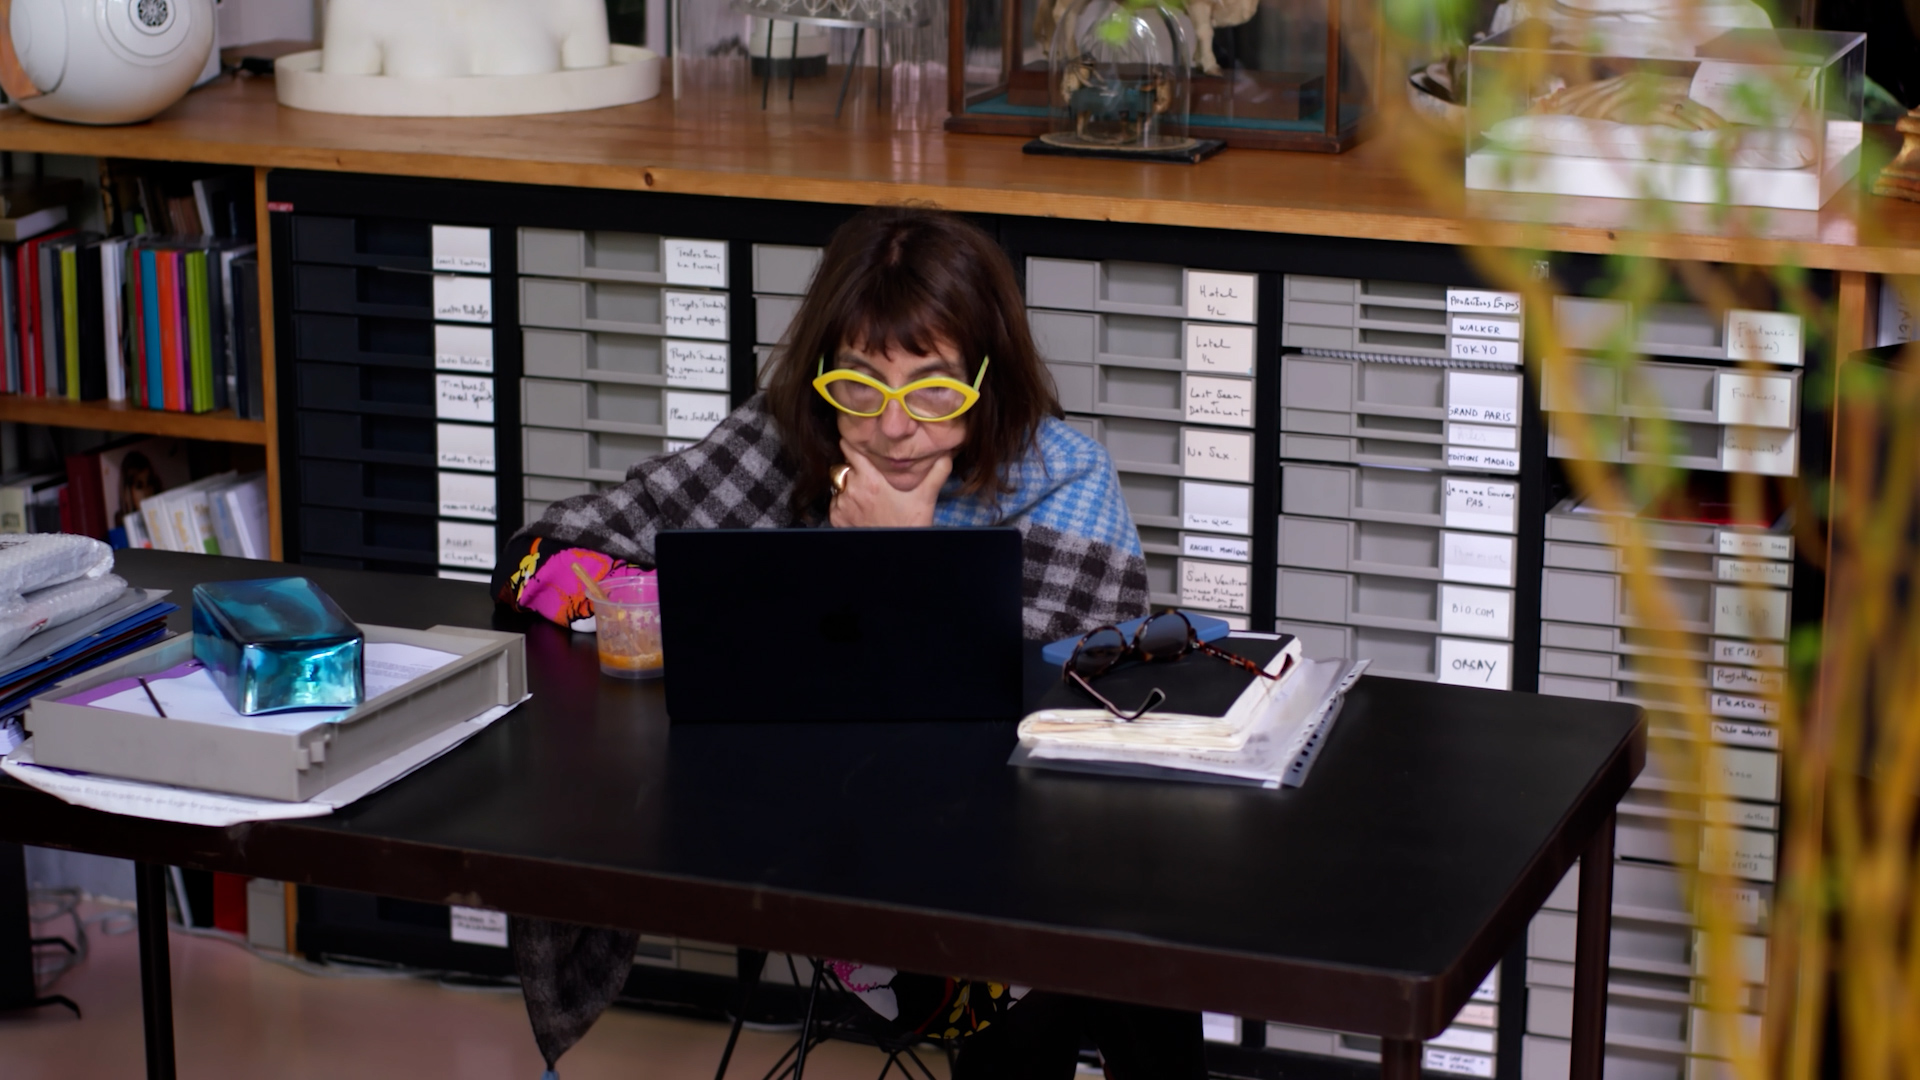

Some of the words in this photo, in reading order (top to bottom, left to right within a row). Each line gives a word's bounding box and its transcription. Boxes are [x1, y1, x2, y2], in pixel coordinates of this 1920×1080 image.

[1459, 324, 1501, 335] WALKER
[1456, 344, 1498, 356] TOKYO
[1190, 387, 1212, 399] Last
[1187, 446, 1202, 457] No
